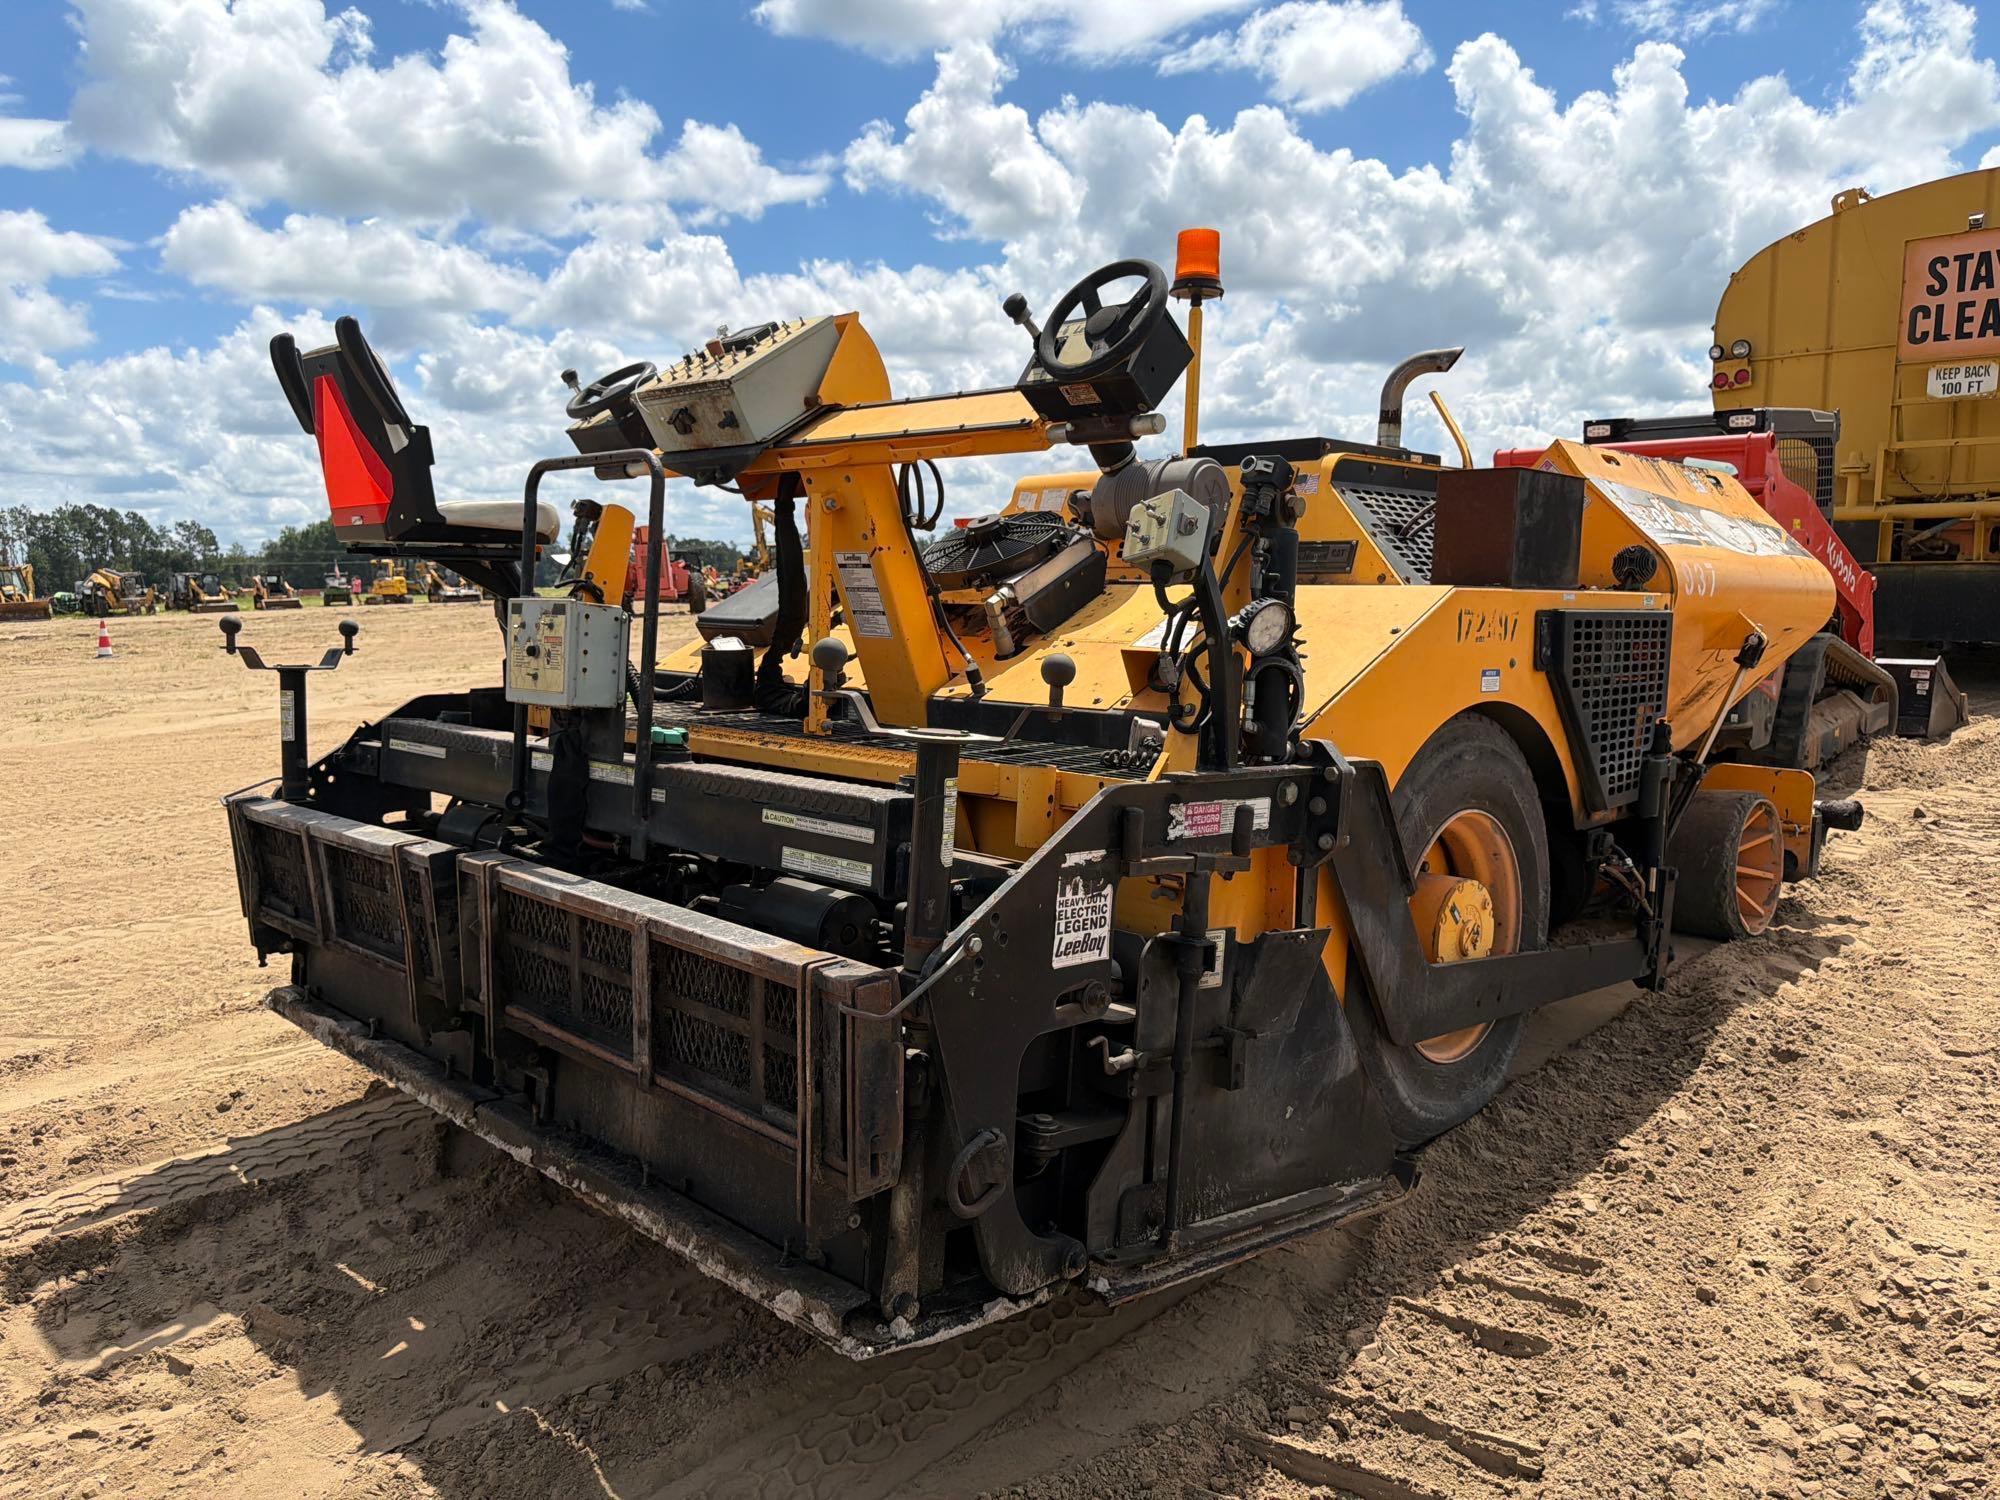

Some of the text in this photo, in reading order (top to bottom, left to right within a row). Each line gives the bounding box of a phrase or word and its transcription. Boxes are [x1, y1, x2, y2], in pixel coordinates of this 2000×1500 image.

[1926, 250, 2000, 297] STA
[1935, 365, 1991, 381] KEEP BACK
[1941, 380, 1984, 395] 100 FT
[1827, 536, 1856, 593] Kubota
[1193, 805, 1220, 814] DANGER
[769, 813, 795, 824] CAUTION
[1058, 893, 1109, 909] HEAVY DUTY
[1057, 904, 1108, 921] ELECTRIC
[1056, 916, 1107, 935] LEGEND
[1055, 933, 1107, 958] LeeBoy
